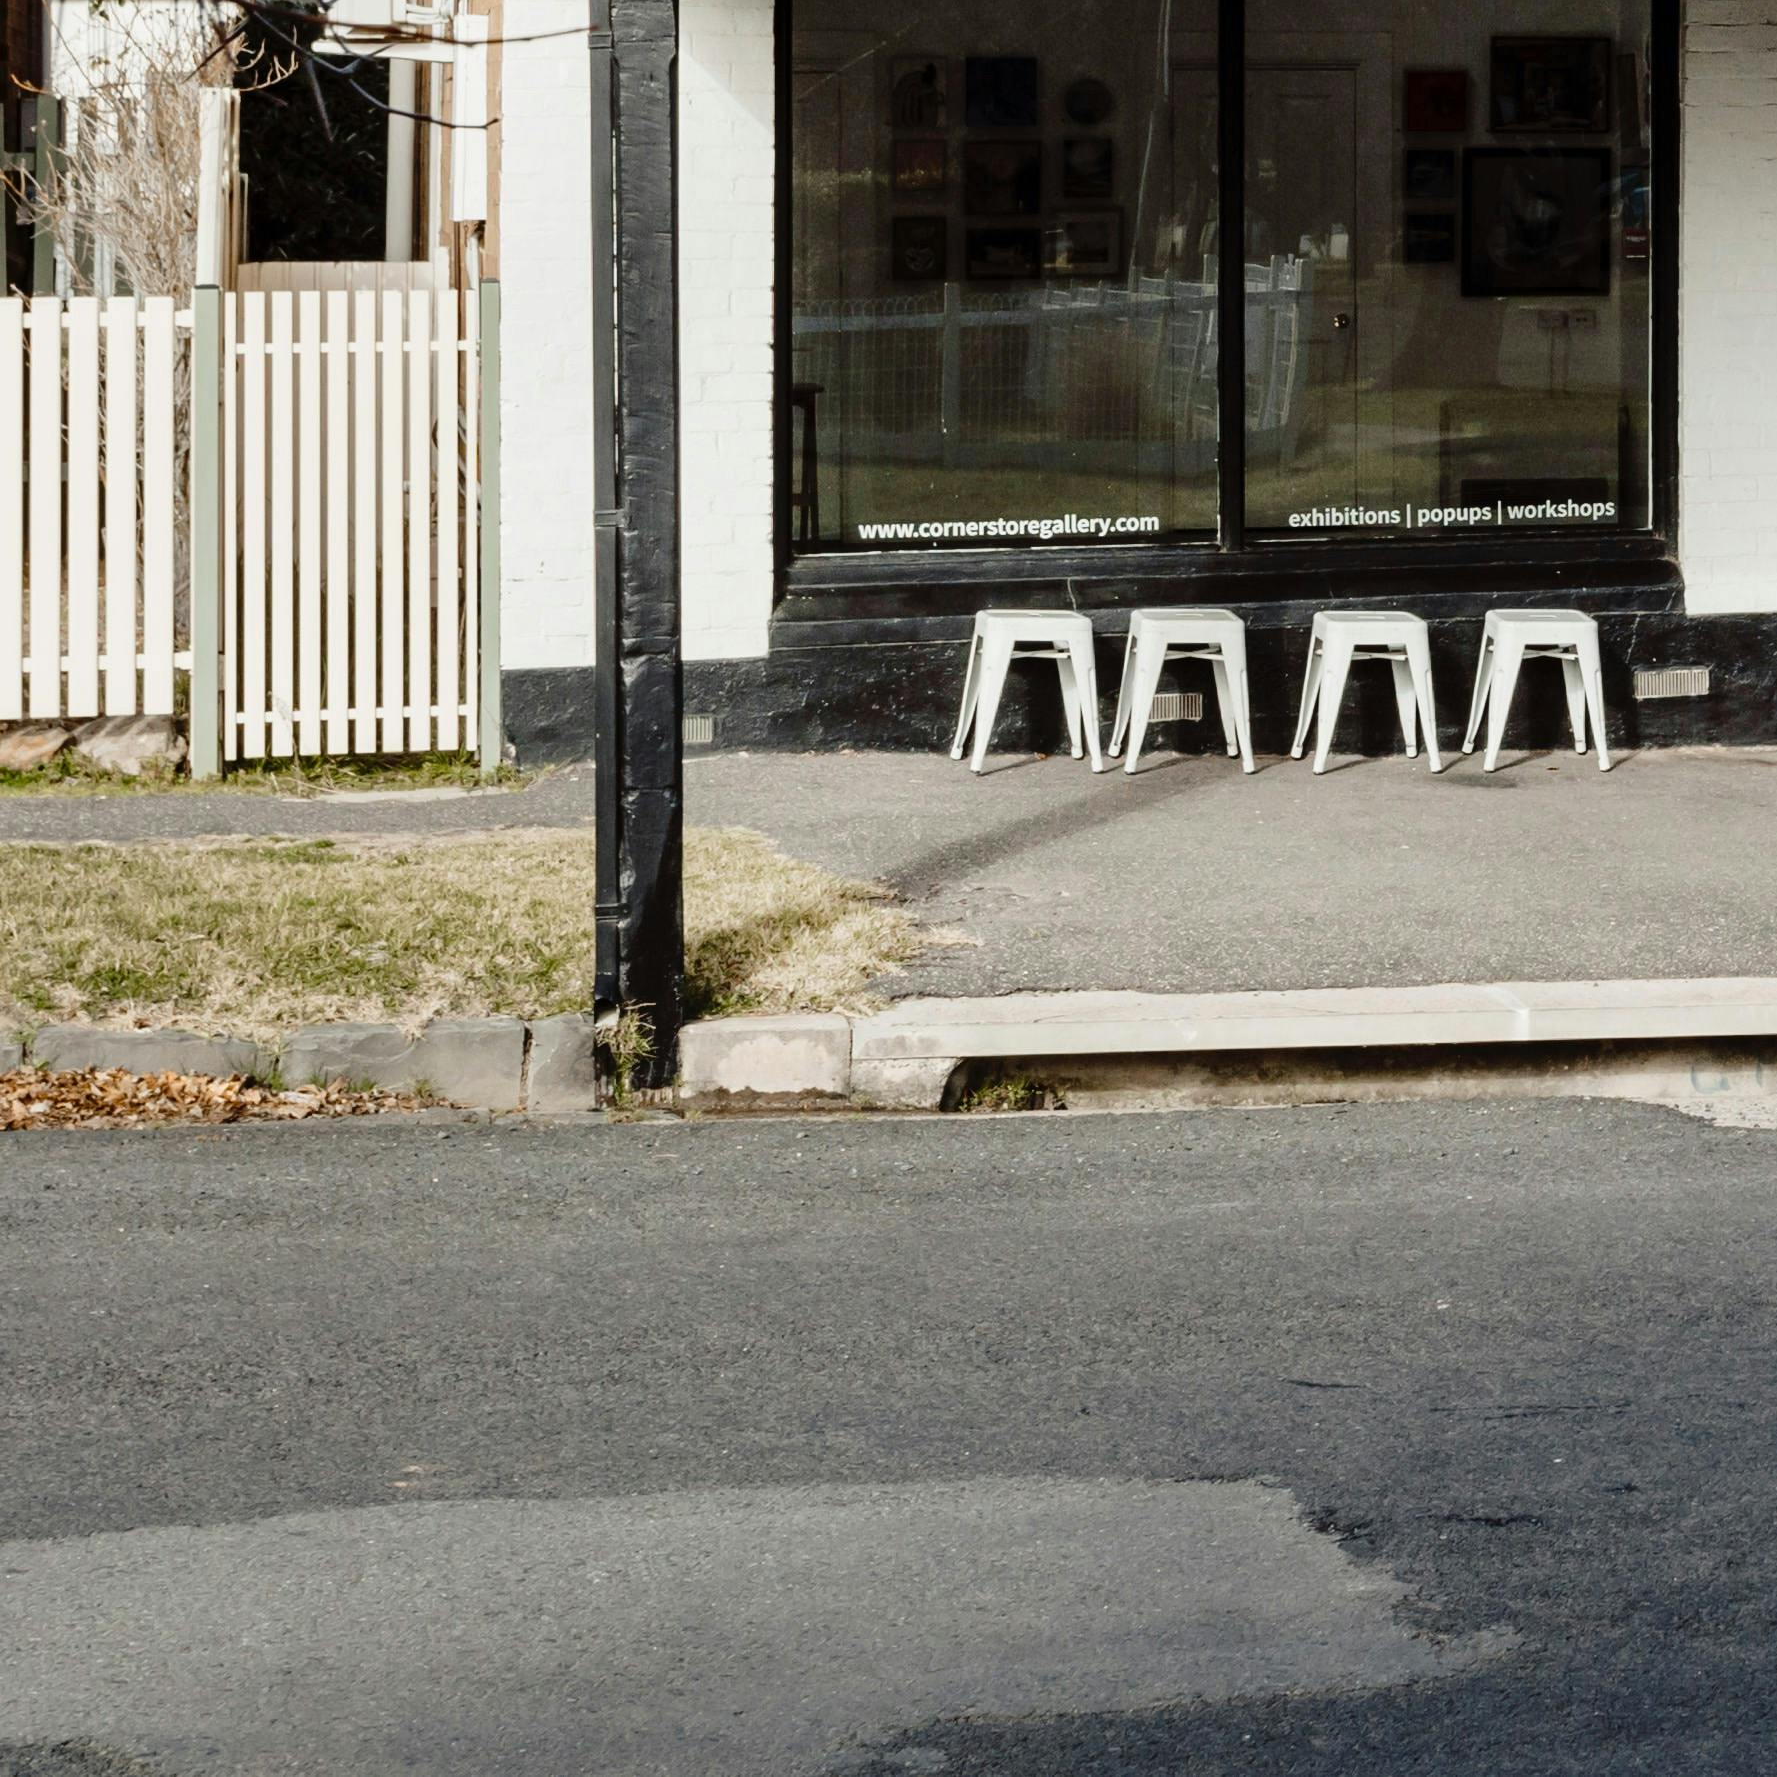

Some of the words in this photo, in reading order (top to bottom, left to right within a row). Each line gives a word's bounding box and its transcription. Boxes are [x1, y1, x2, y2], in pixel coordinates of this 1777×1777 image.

[858, 513, 1160, 539] www.cornerstoregallery.com
[1288, 506, 1401, 528] exhibitions
[1417, 504, 1492, 527] popups
[1507, 498, 1616, 521] workshops
